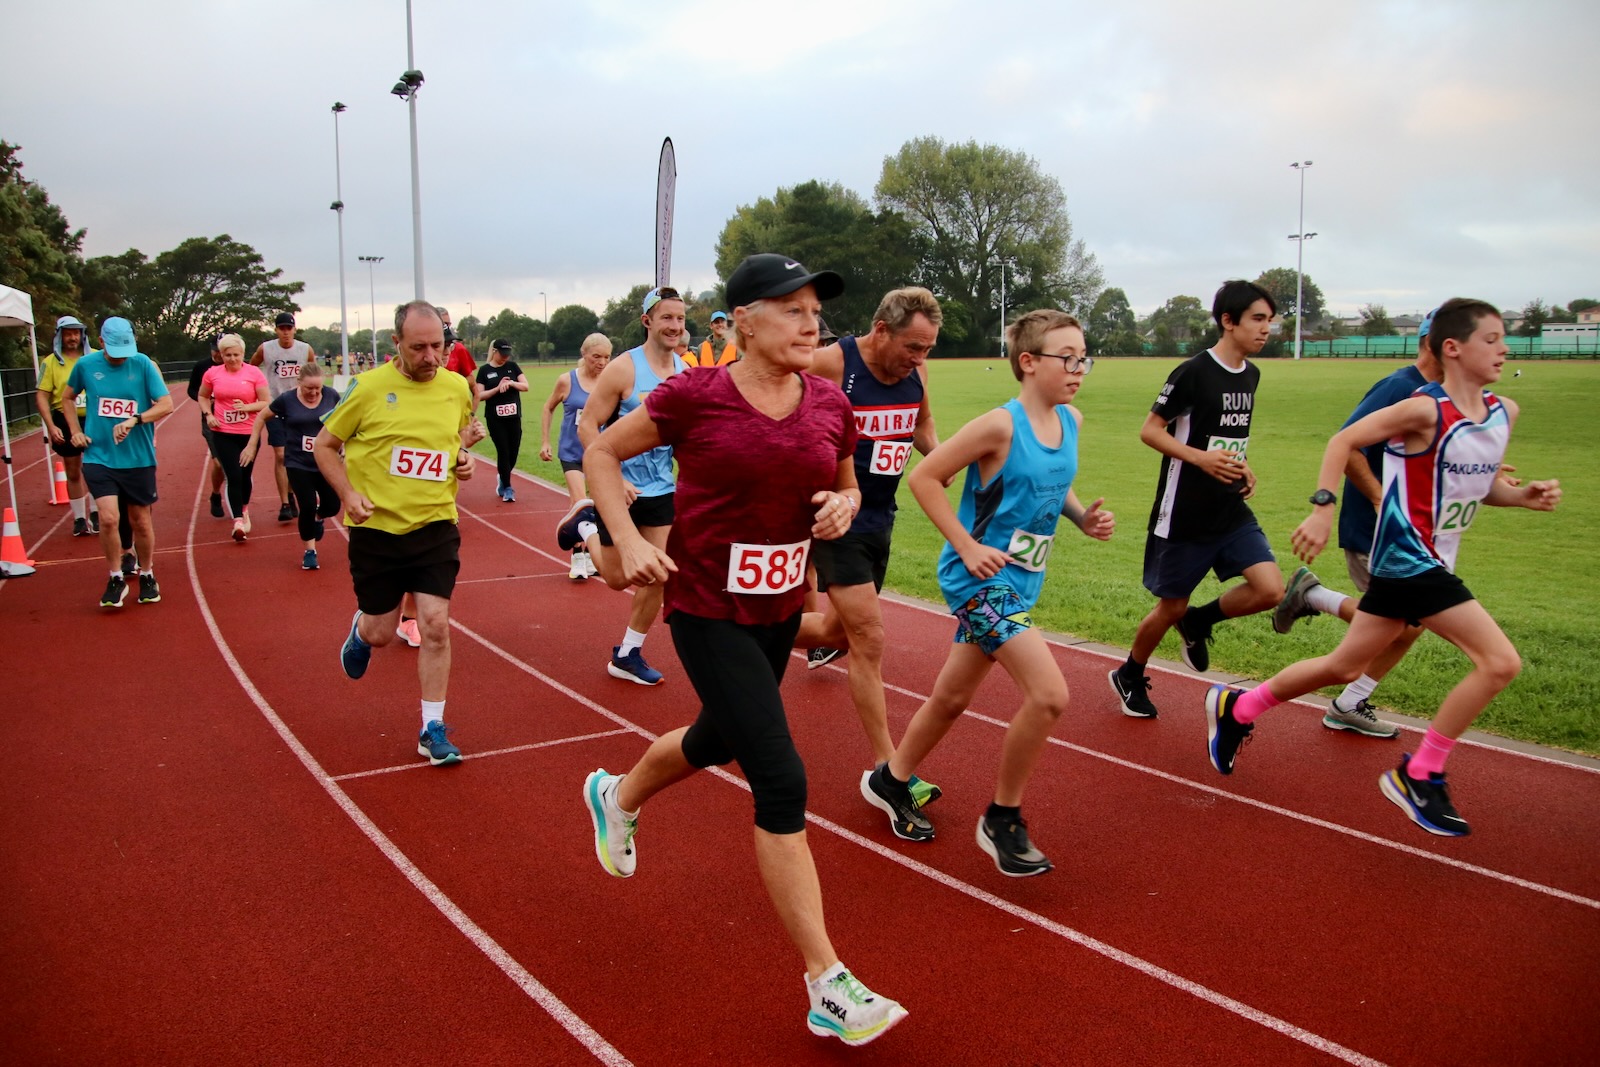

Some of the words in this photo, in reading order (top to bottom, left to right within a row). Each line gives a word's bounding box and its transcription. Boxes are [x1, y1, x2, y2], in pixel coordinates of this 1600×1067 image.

[281, 365, 300, 377] 576
[102, 400, 134, 416] 564
[498, 405, 515, 415] 563
[1222, 393, 1252, 411] RUN
[225, 410, 246, 422] 575
[1220, 413, 1249, 427] MORE
[397, 450, 442, 477] 574
[737, 546, 804, 590] 583
[822, 997, 847, 1022] HOKA
